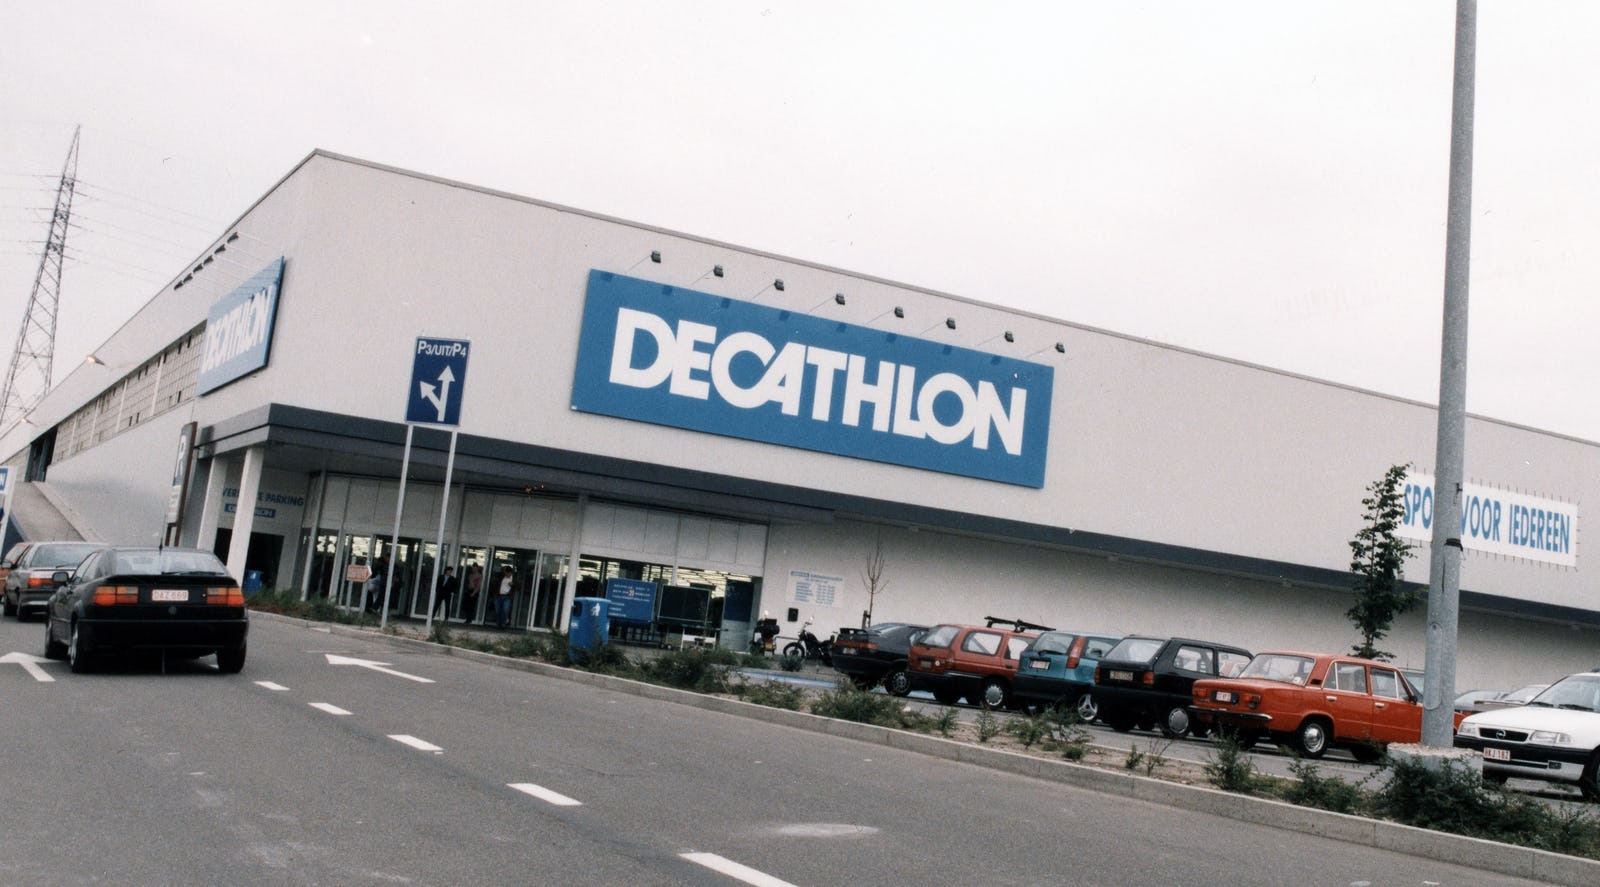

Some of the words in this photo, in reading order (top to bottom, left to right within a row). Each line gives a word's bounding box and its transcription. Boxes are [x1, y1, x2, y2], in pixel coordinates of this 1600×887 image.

[609, 307, 1026, 456] DECATHLON
[264, 492, 305, 507] PARKING
[1403, 483, 1433, 529] SPO
[1508, 503, 1570, 554] IEDEREEN
